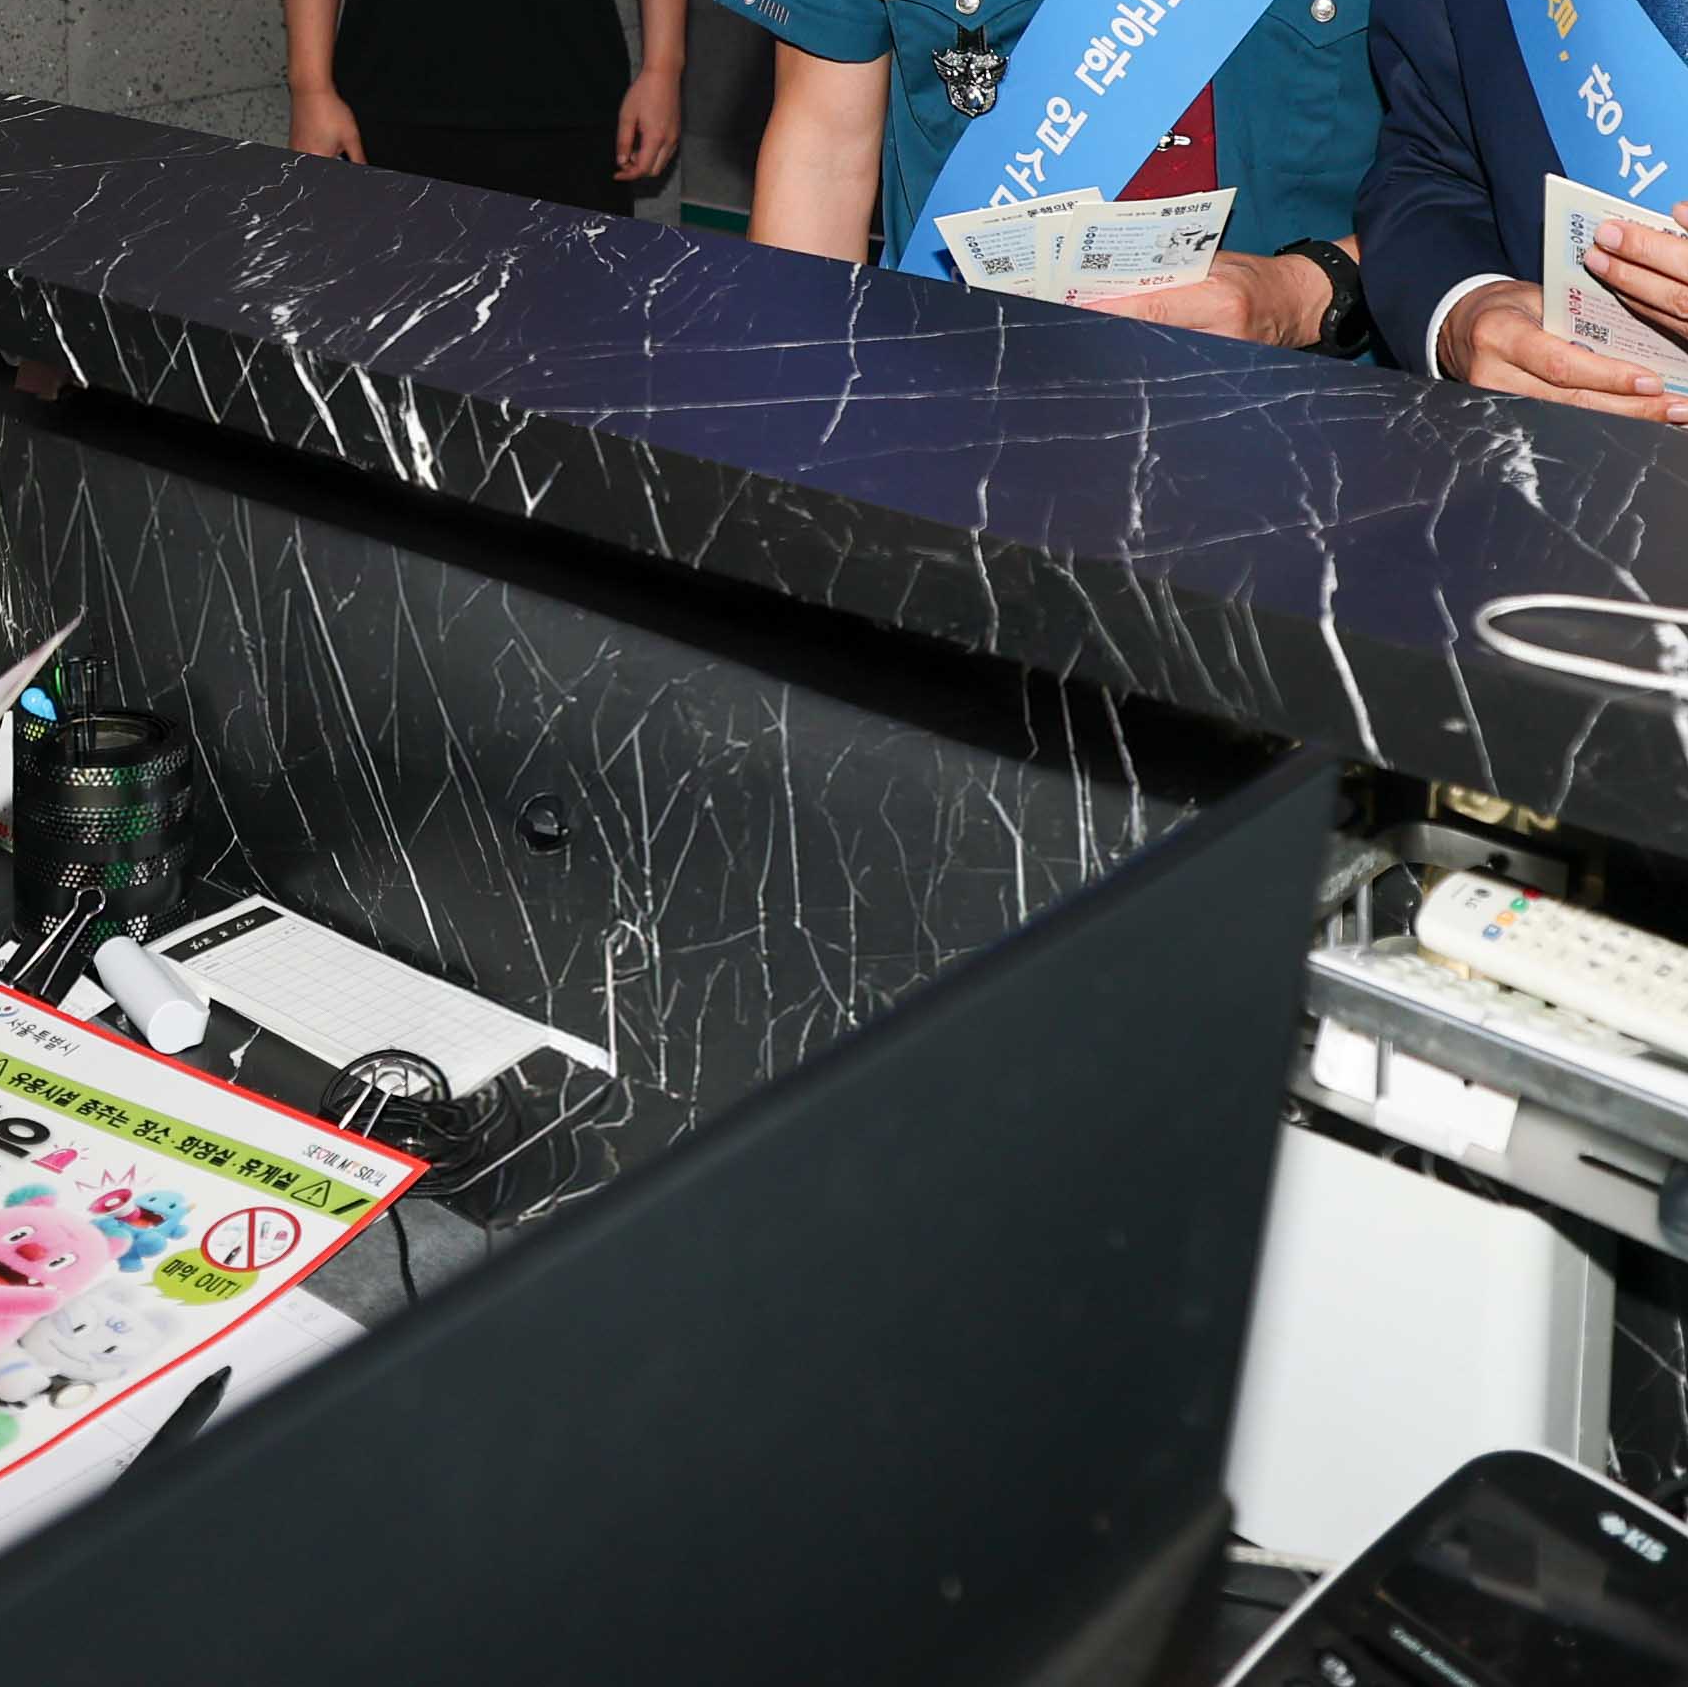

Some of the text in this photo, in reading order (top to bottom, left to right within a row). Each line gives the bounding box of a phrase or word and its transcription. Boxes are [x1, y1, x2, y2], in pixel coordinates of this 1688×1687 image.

[1577, 62, 1668, 199] 장소
[7, 1017, 80, 1057] 서울특별시
[8, 1071, 82, 1108] 유흥시설
[76, 1098, 131, 1129] 춤추는
[161, 1258, 242, 1300] 마약 OUT!
